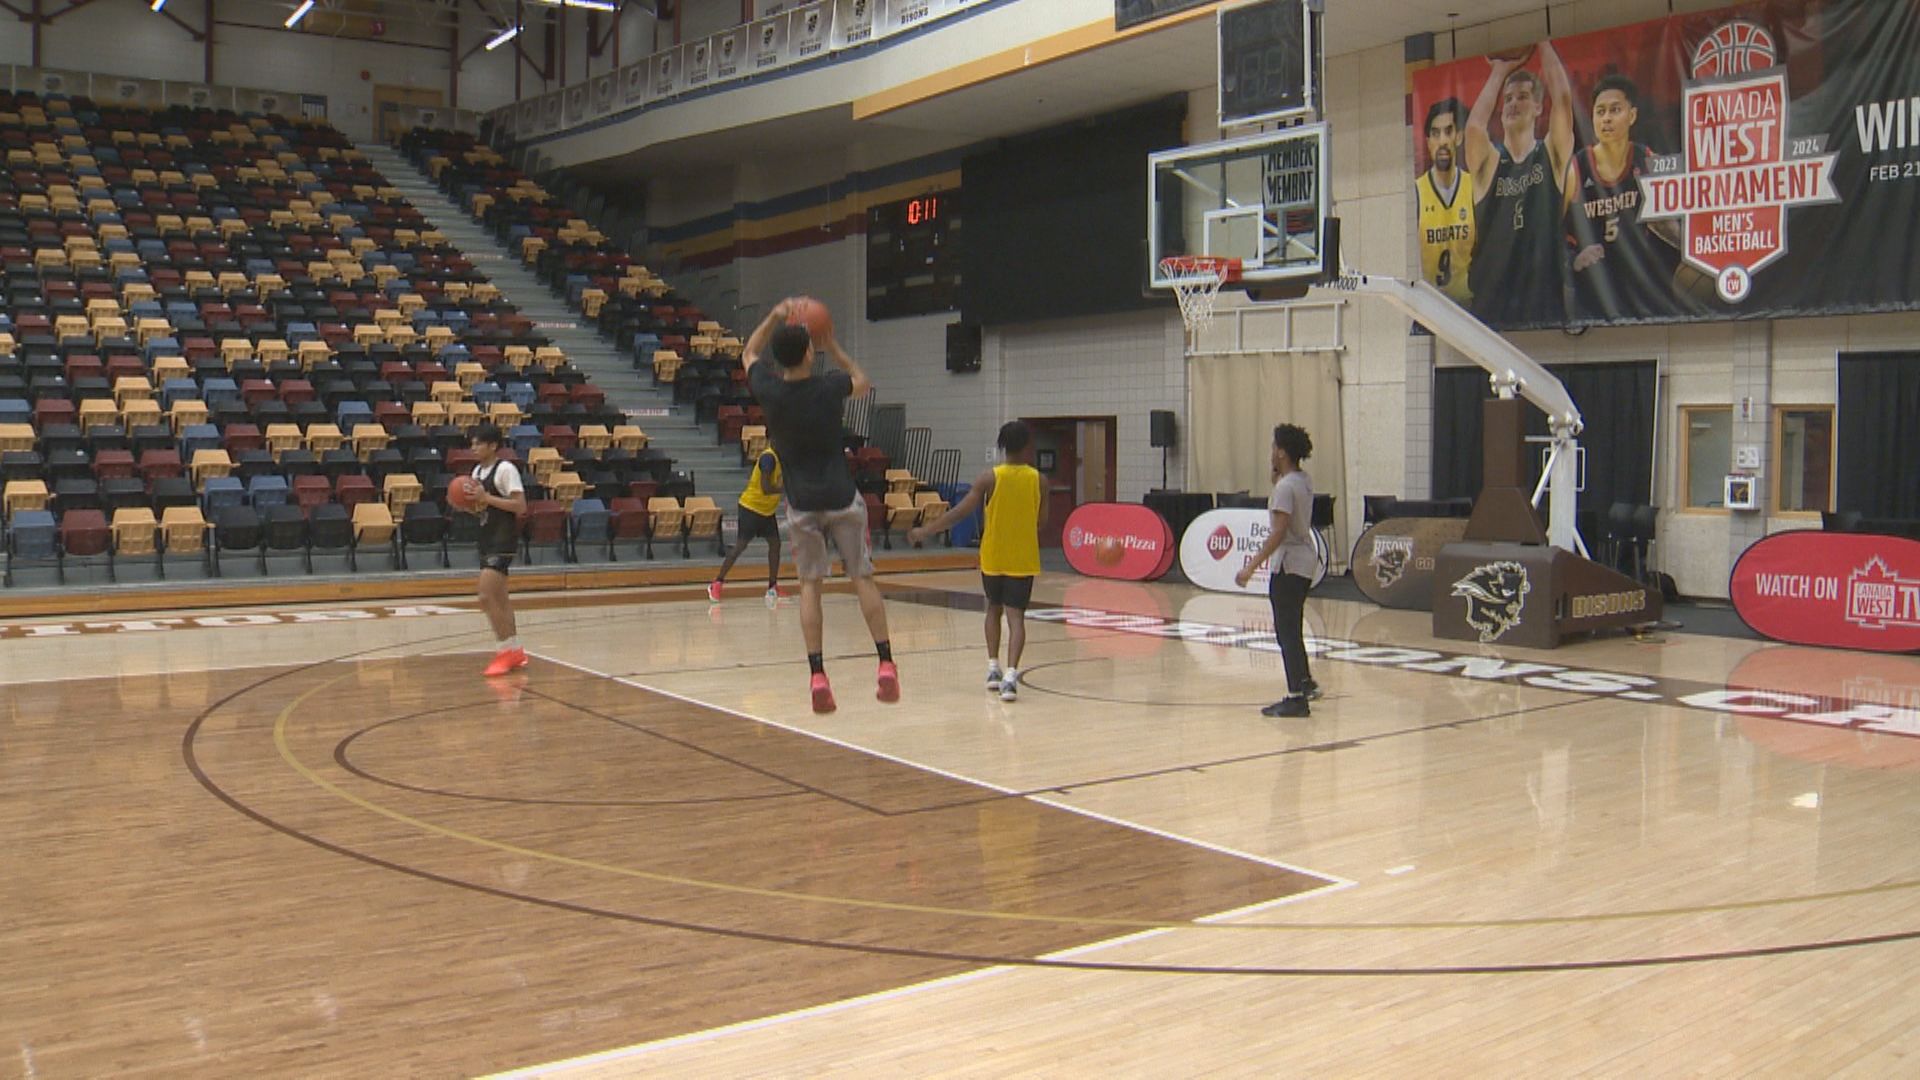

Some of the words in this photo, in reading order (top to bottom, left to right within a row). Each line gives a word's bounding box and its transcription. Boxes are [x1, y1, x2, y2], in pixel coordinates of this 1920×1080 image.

[901, 7, 929, 24] BISONS
[1693, 88, 1776, 125] CANADA
[1693, 120, 1776, 167] WEST
[1792, 138, 1819, 155] 2024
[1653, 157, 1677, 173] 2023
[1870, 165, 1900, 183] FEB
[1650, 162, 1823, 212] TOURNAMENT
[908, 197, 937, 225] 10:11
[1583, 191, 1638, 219] WESMEN
[1604, 218, 1620, 242] 5
[1712, 212, 1754, 233] MEN'S
[1695, 230, 1775, 254] BASKETBALL
[1436, 249, 1451, 287] 9
[1250, 522, 1272, 538] Bes
[1124, 535, 1156, 551] Pizza
[1210, 536, 1231, 550] BW
[1375, 539, 1413, 560] BISONS
[1756, 573, 1810, 599] WATCH
[1814, 576, 1838, 601] ON
[1856, 583, 1892, 599] CANADA
[1572, 589, 1646, 618] BISONS
[1856, 597, 1891, 616] WEST
